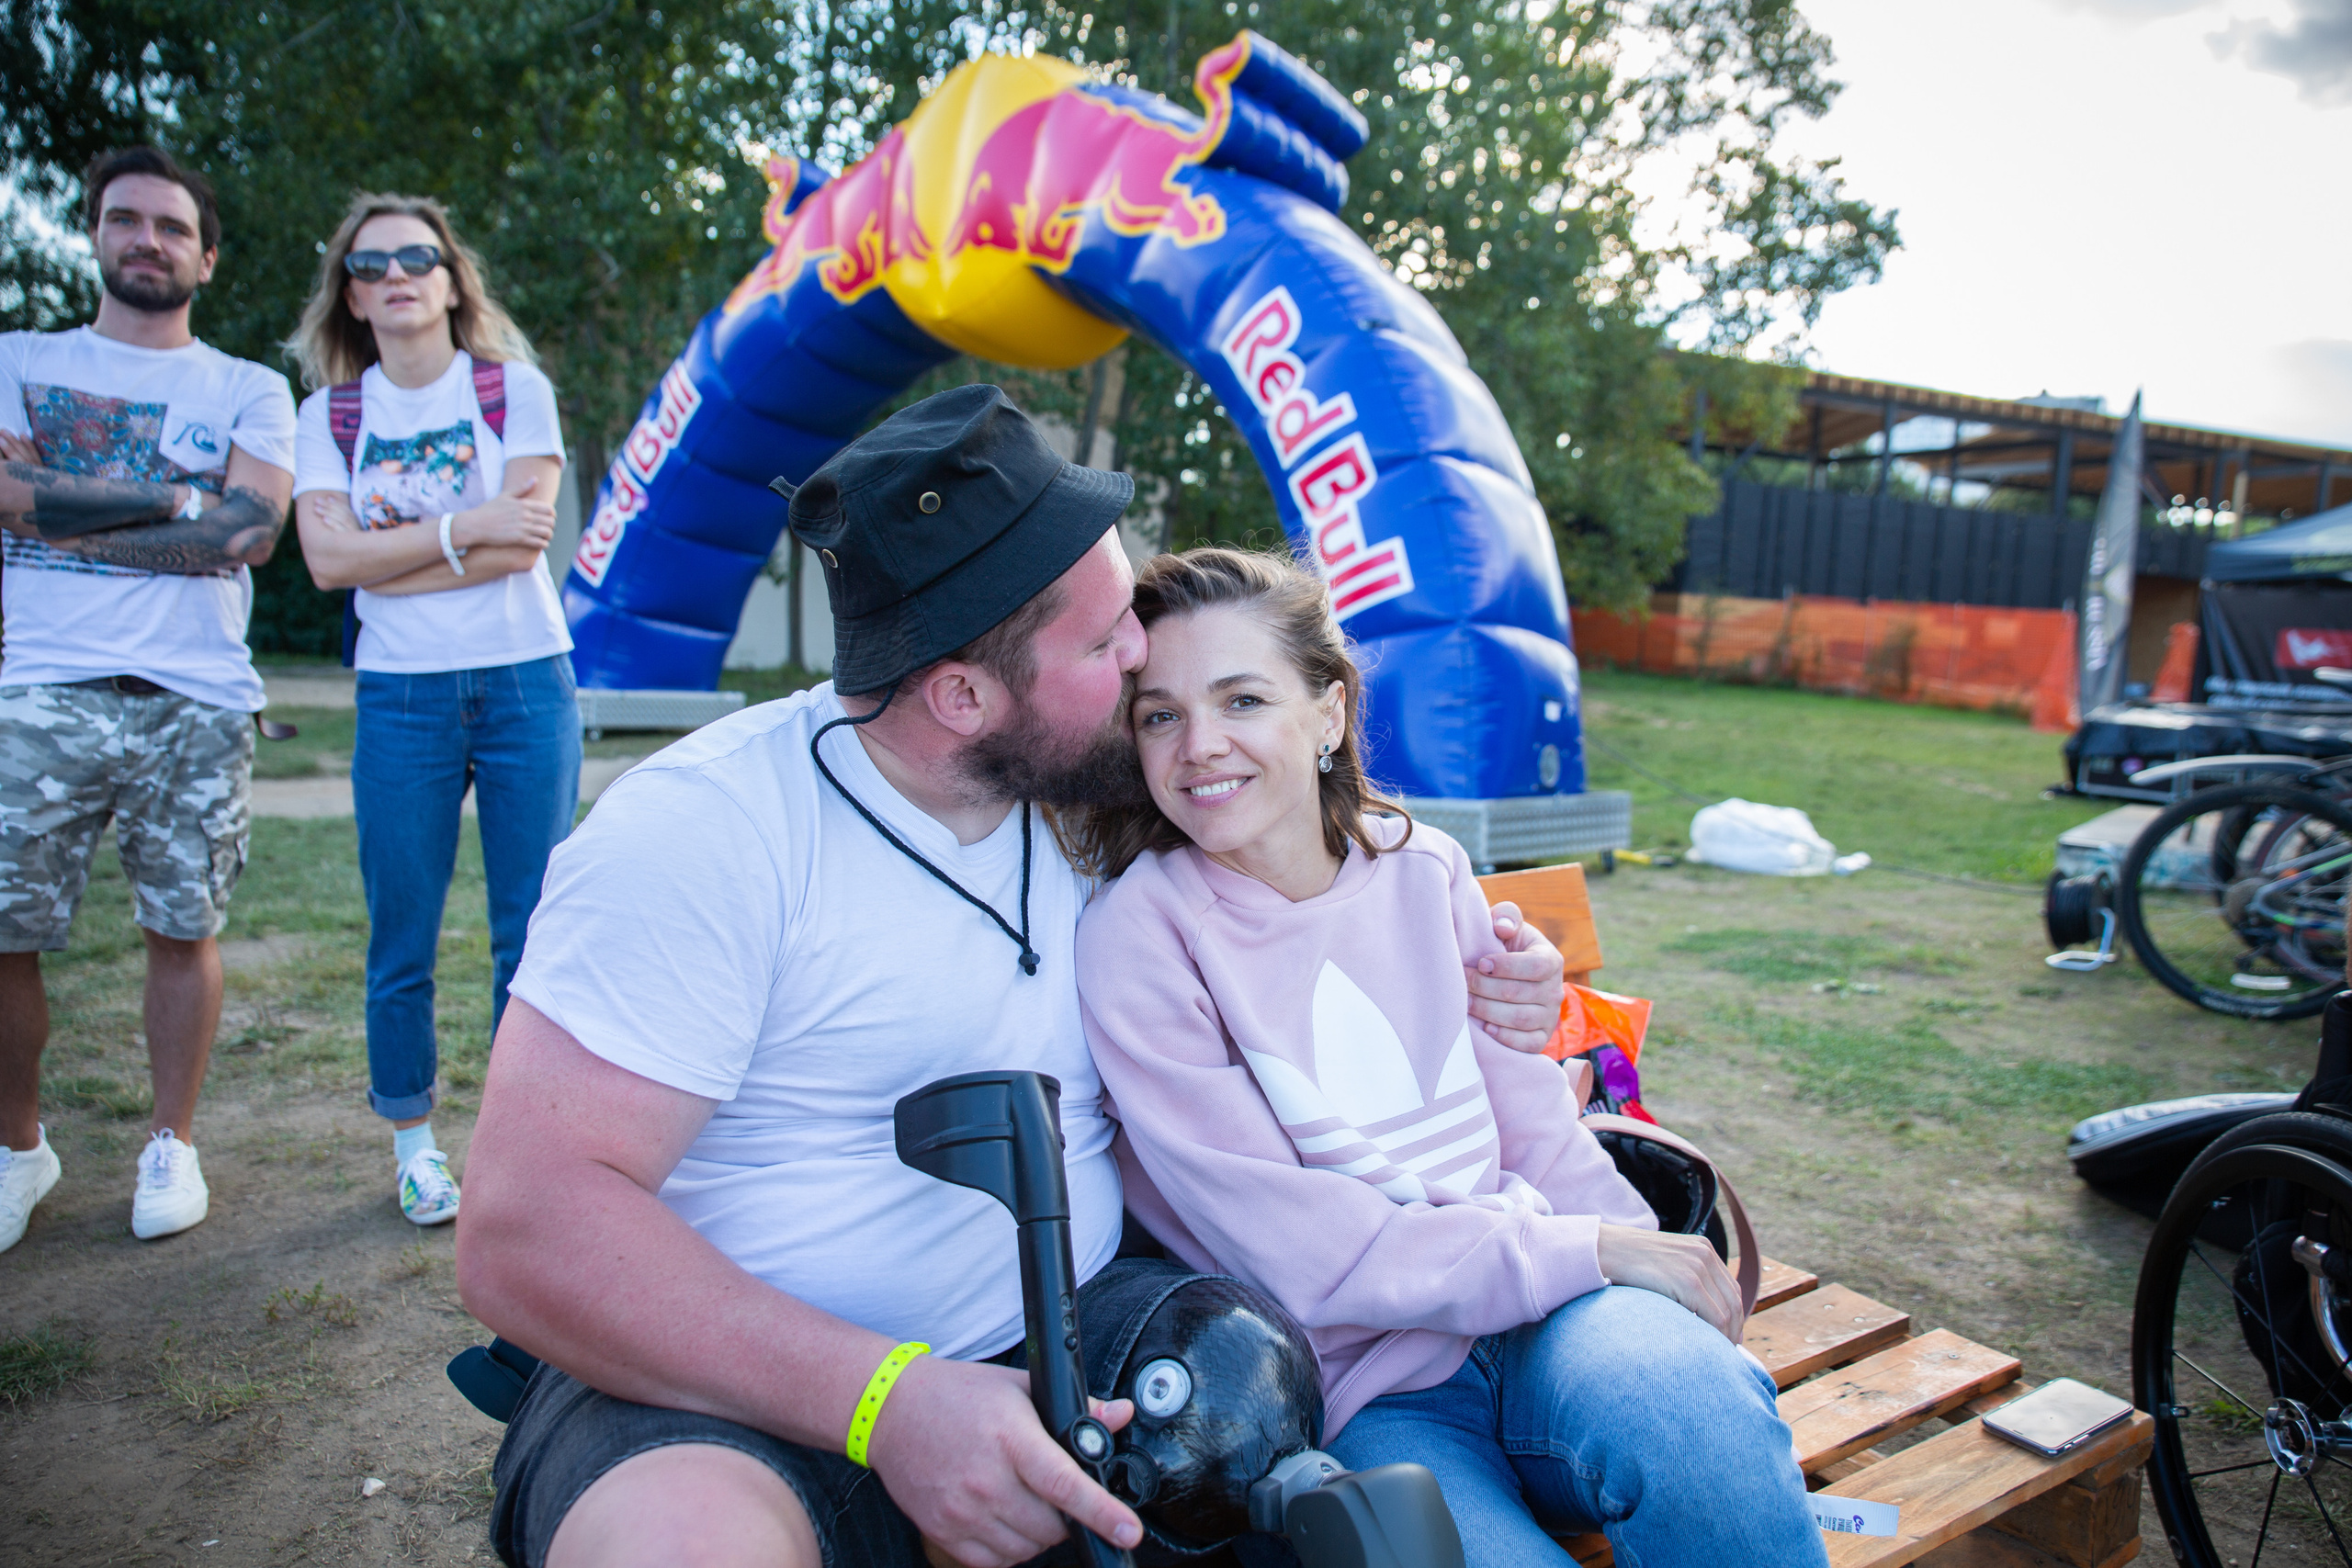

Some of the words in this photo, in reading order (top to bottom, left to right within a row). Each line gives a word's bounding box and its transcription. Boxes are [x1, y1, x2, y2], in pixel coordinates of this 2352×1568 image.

[576, 463, 641, 578] Red
[629, 365, 694, 474] Bull
[1229, 296, 1347, 459] Red
[1297, 445, 1402, 613] Bull
